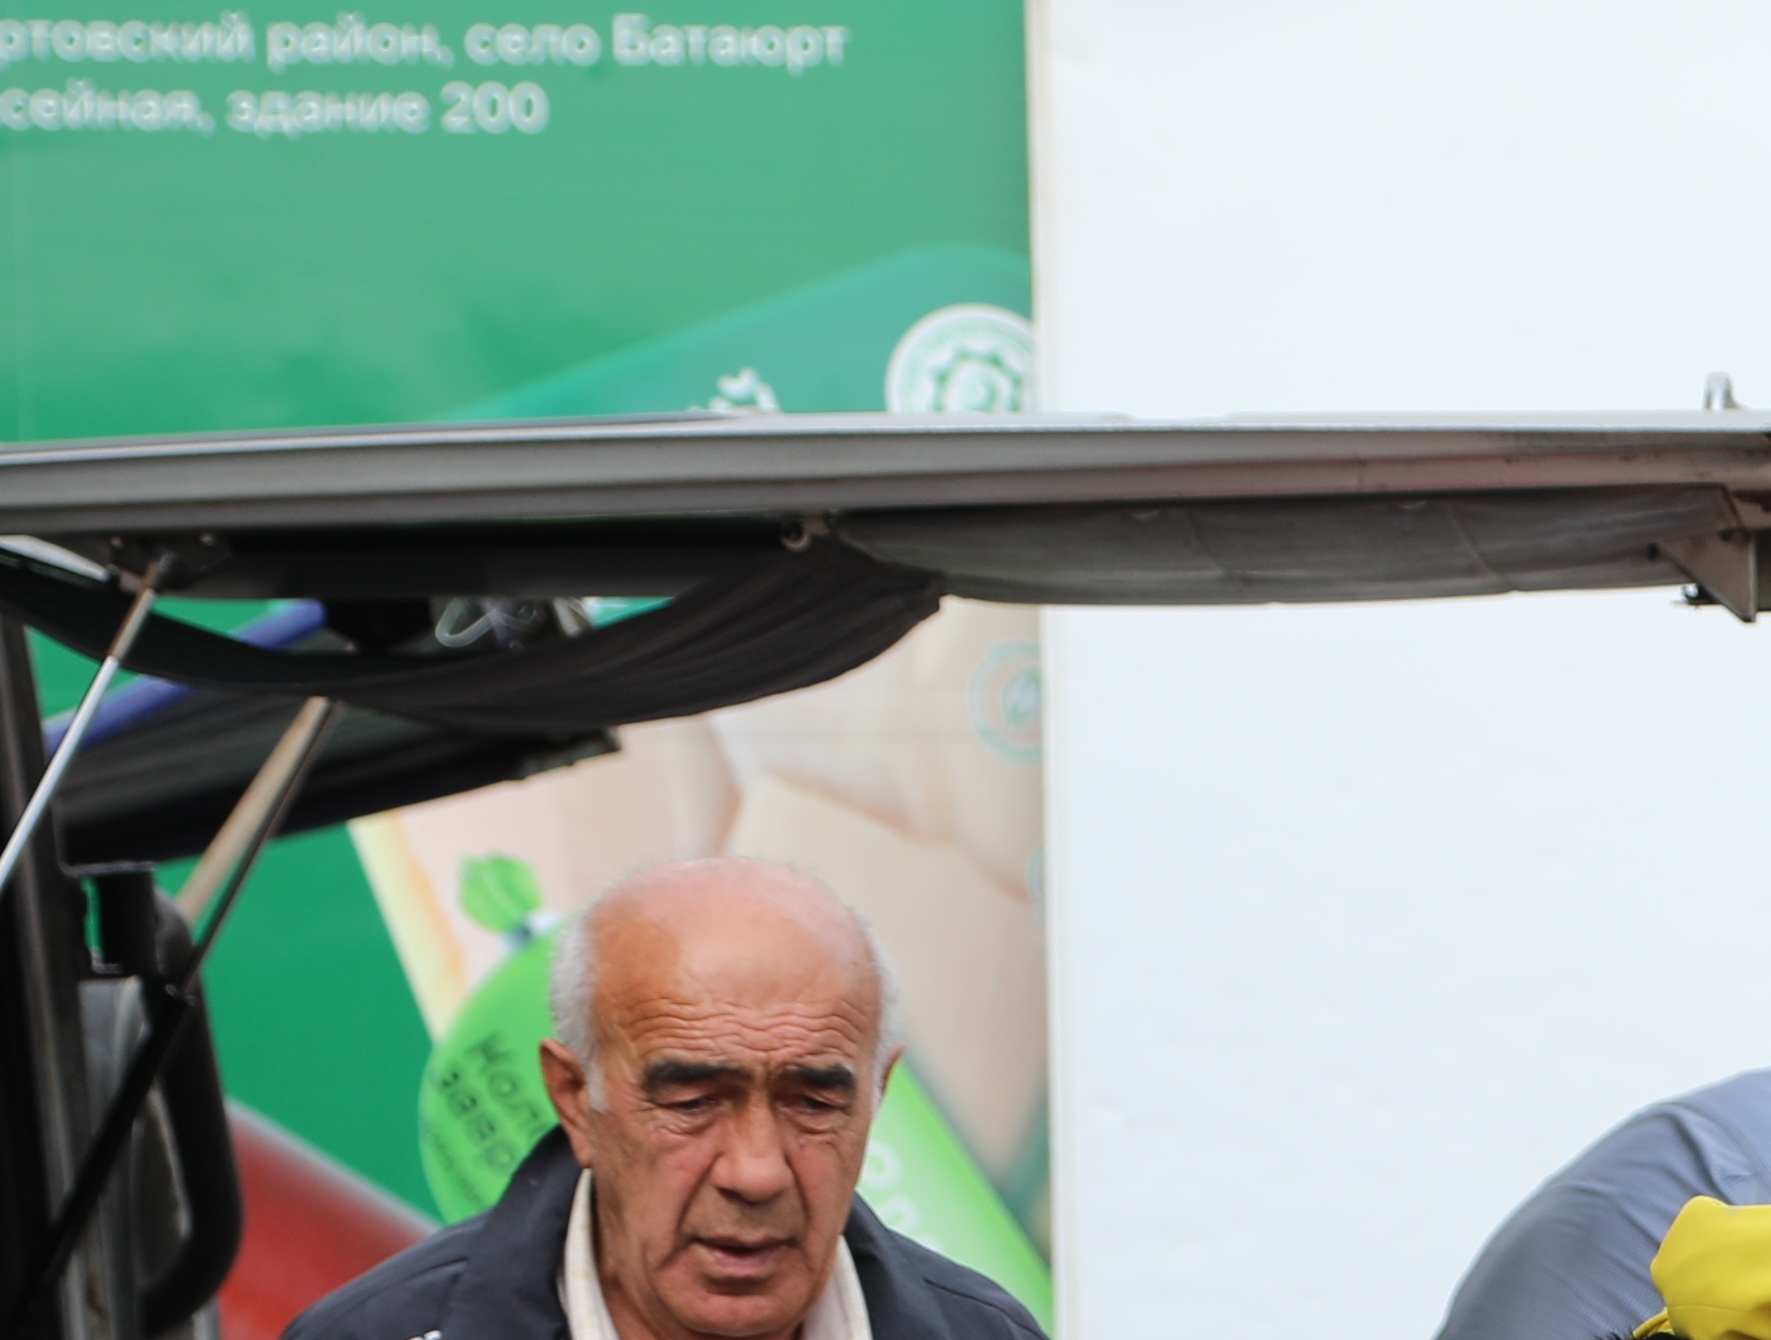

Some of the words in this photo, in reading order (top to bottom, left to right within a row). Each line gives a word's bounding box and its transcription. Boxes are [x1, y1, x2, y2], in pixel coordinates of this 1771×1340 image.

[267, 11, 455, 74] район,
[464, 22, 602, 67] село
[611, 12, 850, 76] Батаюрт
[226, 89, 431, 139] здание
[440, 80, 550, 135] 200
